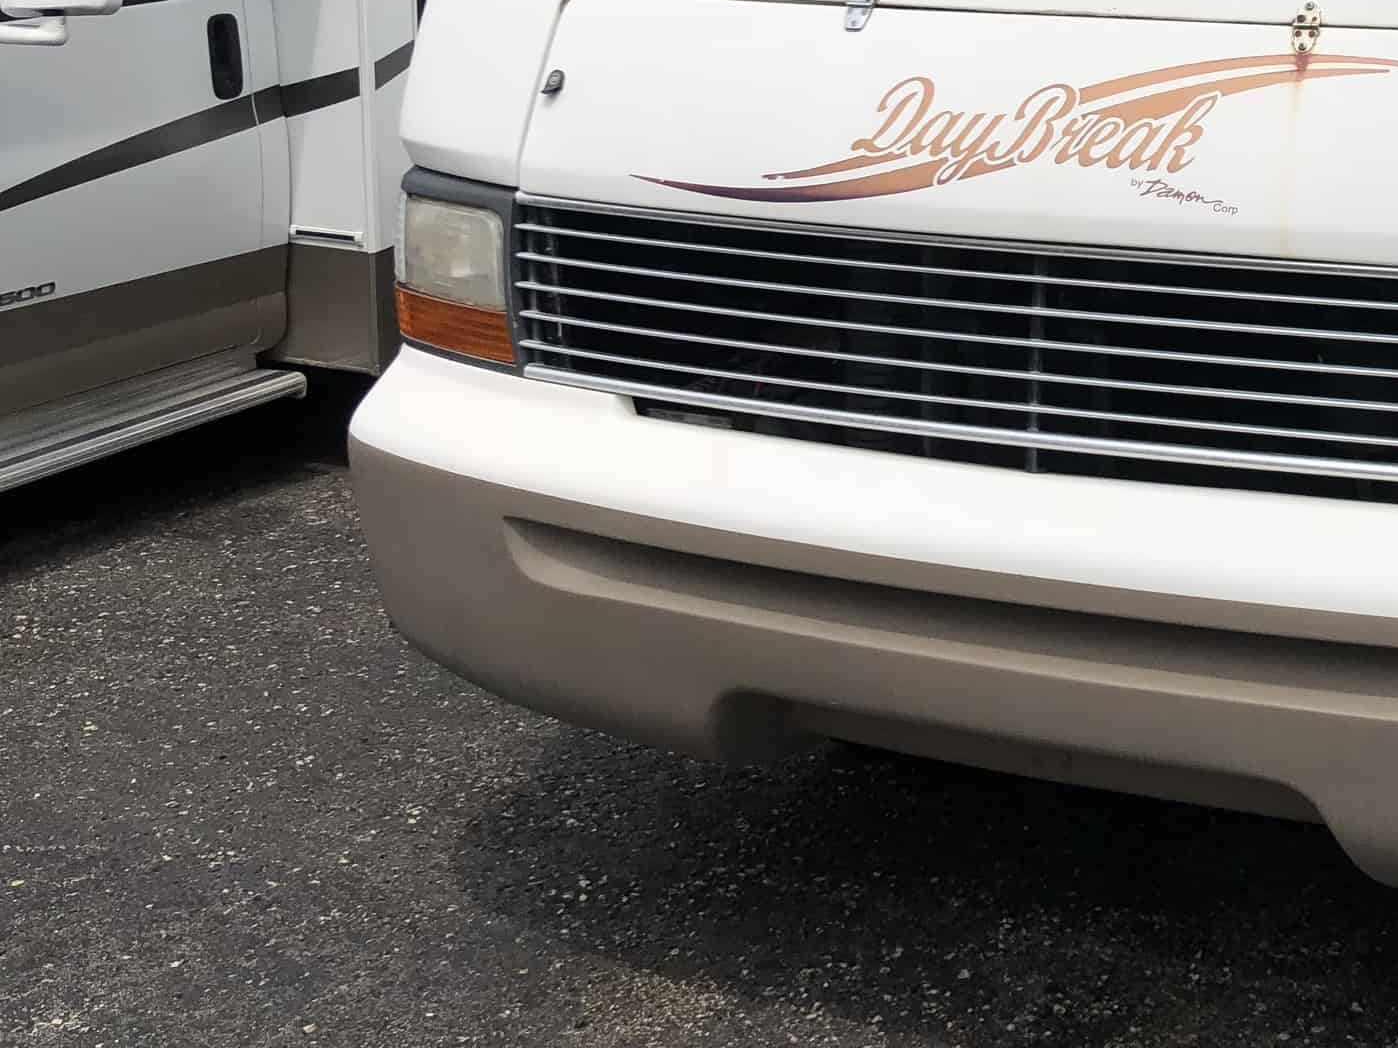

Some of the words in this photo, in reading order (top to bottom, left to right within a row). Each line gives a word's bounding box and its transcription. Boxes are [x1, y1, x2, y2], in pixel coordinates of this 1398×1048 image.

[1130, 178, 1144, 189] by
[1140, 179, 1224, 205] Damon
[1212, 203, 1239, 215] Corp
